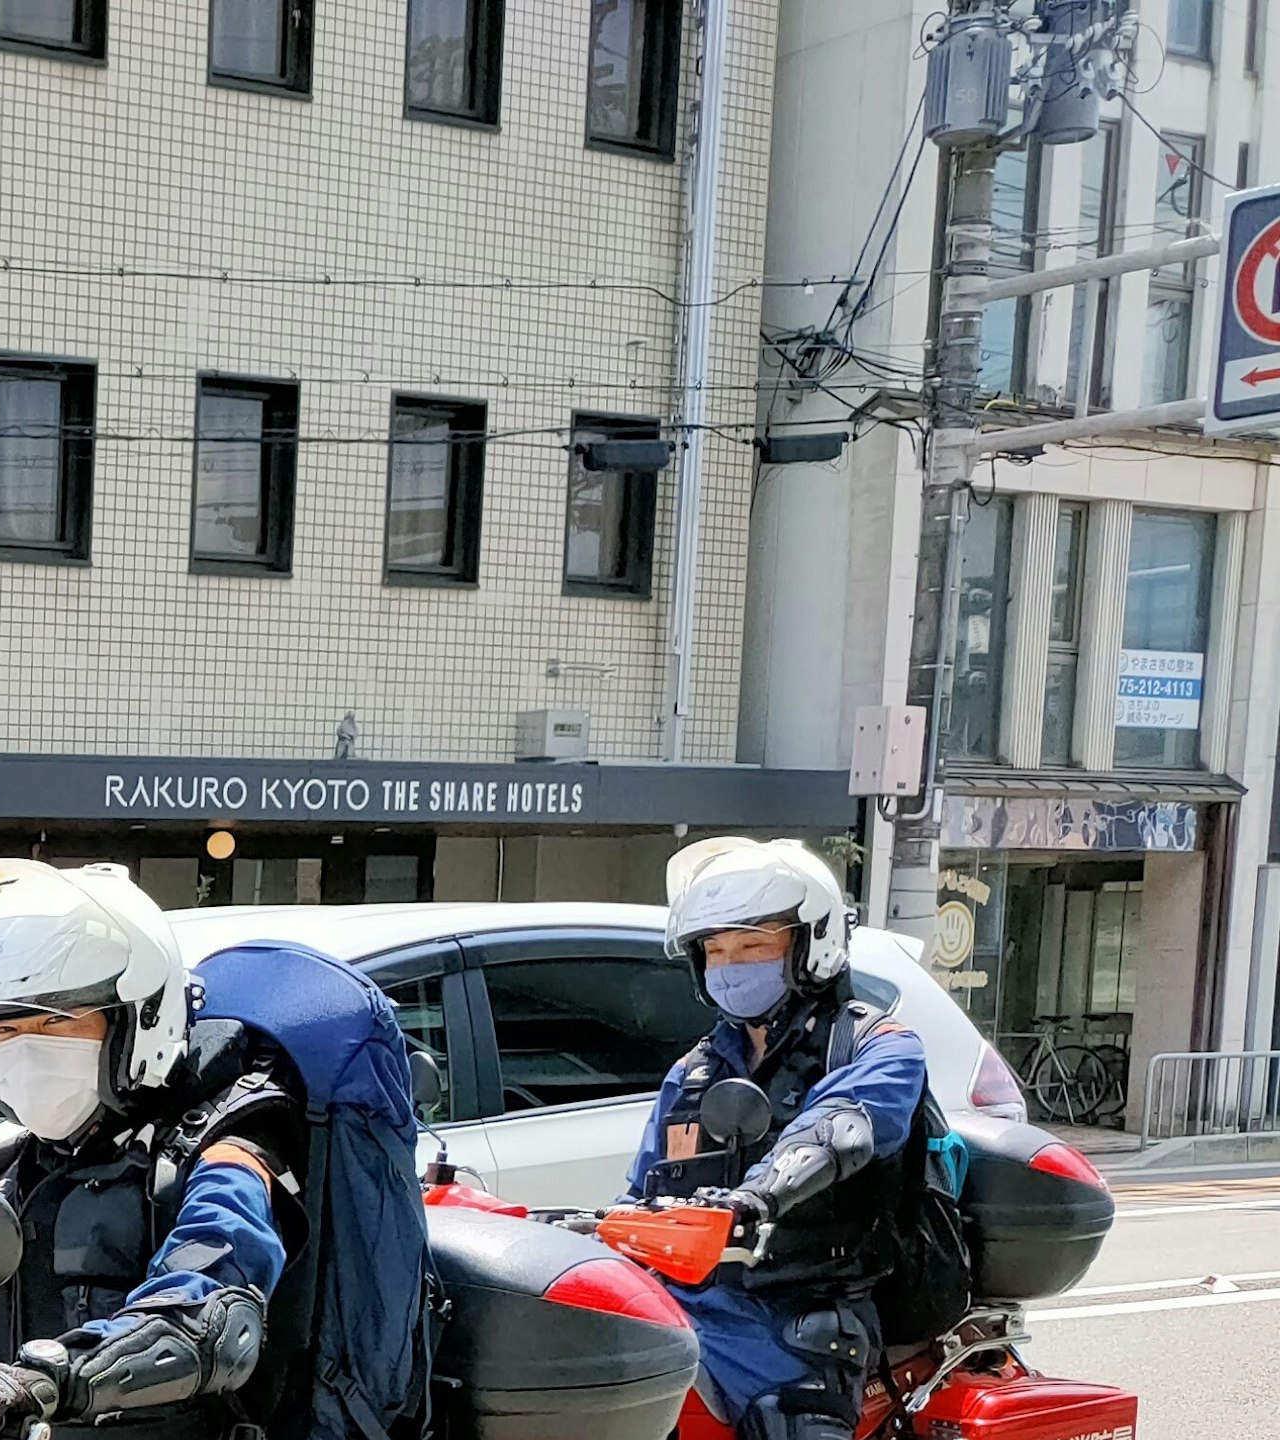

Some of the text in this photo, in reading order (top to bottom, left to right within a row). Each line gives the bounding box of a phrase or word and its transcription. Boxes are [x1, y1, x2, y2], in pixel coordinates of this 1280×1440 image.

[105, 775, 583, 815] RAKURO KYOTO THE SHARE HOTELS
